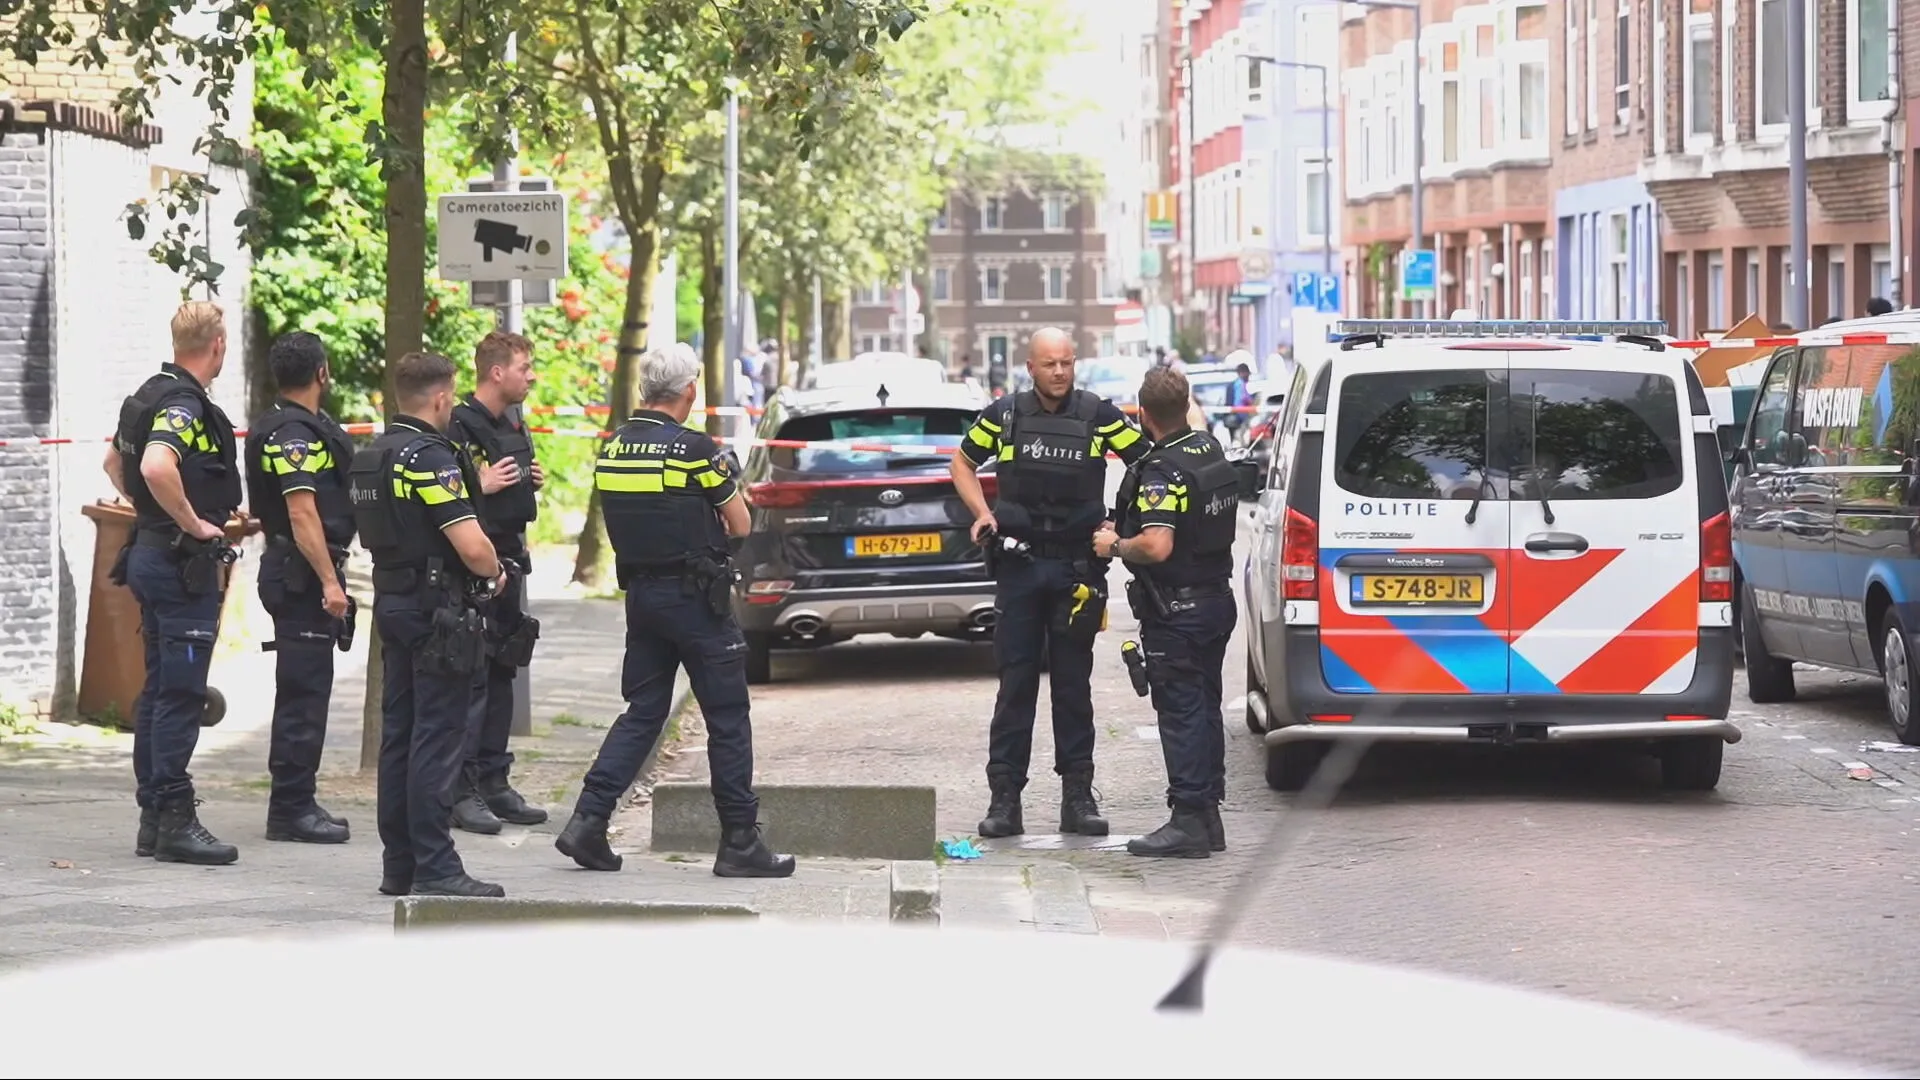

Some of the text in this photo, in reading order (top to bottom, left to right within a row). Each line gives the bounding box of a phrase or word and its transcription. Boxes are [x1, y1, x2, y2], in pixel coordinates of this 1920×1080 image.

[447, 200, 558, 213] Cameratoezicht
[1296, 272, 1312, 293] P
[1319, 275, 1336, 297] P
[1022, 437, 1083, 460] POLITIE
[1345, 502, 1438, 516] POLITIE
[862, 535, 933, 554] H-679-JJ
[1373, 578, 1472, 599] S-748-JR
